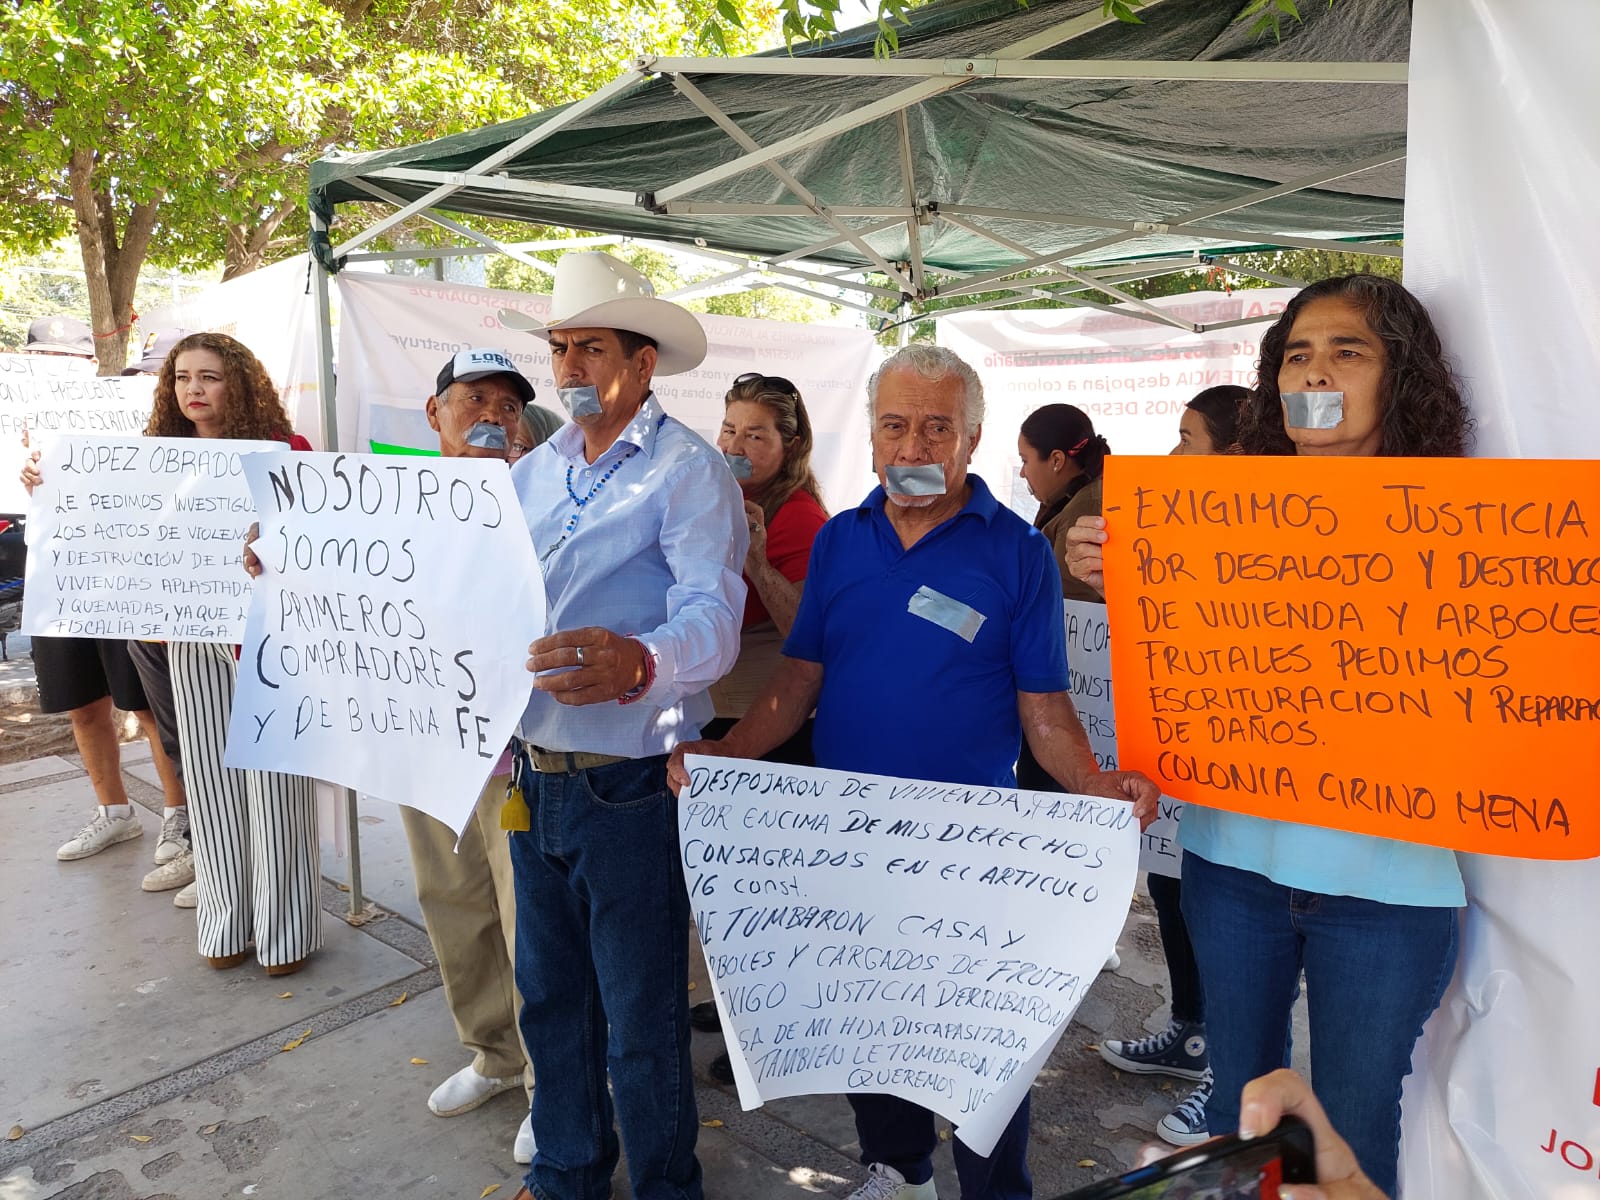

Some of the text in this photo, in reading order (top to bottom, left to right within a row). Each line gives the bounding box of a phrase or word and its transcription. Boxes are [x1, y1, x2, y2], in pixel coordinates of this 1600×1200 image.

[55, 488, 79, 514] LE
[89, 493, 164, 513] PEDIMOS
[268, 454, 502, 529] NOSOTROS
[1132, 486, 1339, 536] EXIGIMOS
[1382, 484, 1589, 540] JUSTICIA
[52, 521, 87, 541] LOS
[94, 522, 150, 541] ACTOS
[157, 524, 182, 542] DE
[52, 549, 61, 567] Y
[192, 552, 217, 570] DE
[1132, 537, 1198, 587] POR
[1215, 550, 1395, 586] DESALOJO
[1417, 548, 1435, 590] Y
[55, 574, 152, 592] VIVIENDAS
[56, 597, 65, 616] Y
[174, 605, 193, 622] YA
[196, 605, 228, 621] QUE
[141, 623, 165, 636] SE
[280, 588, 426, 640] PRIMEROS
[1137, 595, 1600, 640] DE VIVIENDA Y ARBOLE
[256, 633, 477, 702] COMPRADORES
[1136, 638, 1510, 681] FRUTALES PEDIMOS
[1148, 685, 1434, 720] ESCRITURACION
[1453, 686, 1474, 724] Y
[253, 695, 494, 759] Y DE BUENA FE
[1154, 716, 1191, 745] DE
[689, 767, 832, 799] DESPOJARON
[837, 777, 880, 800] DE
[1157, 750, 1571, 838] COLONIA CIRINO MENA
[684, 800, 1113, 869] POR ENCIMA DE MIS DERECHOS
[684, 838, 869, 870] CONSAGRADOS
[886, 857, 931, 876] EN
[979, 865, 1100, 903] ARTICULO
[690, 873, 717, 899] 16
[722, 905, 877, 942] TUMBARON
[897, 914, 989, 948] CASA
[1000, 929, 1027, 949] Y
[787, 943, 810, 969] Y
[816, 944, 940, 973] CARGADOS
[947, 953, 988, 975] DE
[720, 979, 1065, 1028] XIGO JUSTICIA DERRIBARON
[774, 1020, 800, 1045] DE
[805, 1016, 830, 1039] MI
[893, 1015, 1029, 1051] DISCAPASITADA
[754, 1043, 846, 1084] TAMBIEN
[852, 1048, 881, 1066] LE
[886, 1041, 995, 1077] TUMBARON
[846, 1067, 957, 1100] QUEREMOS
[1541, 1128, 1600, 1180] JO
